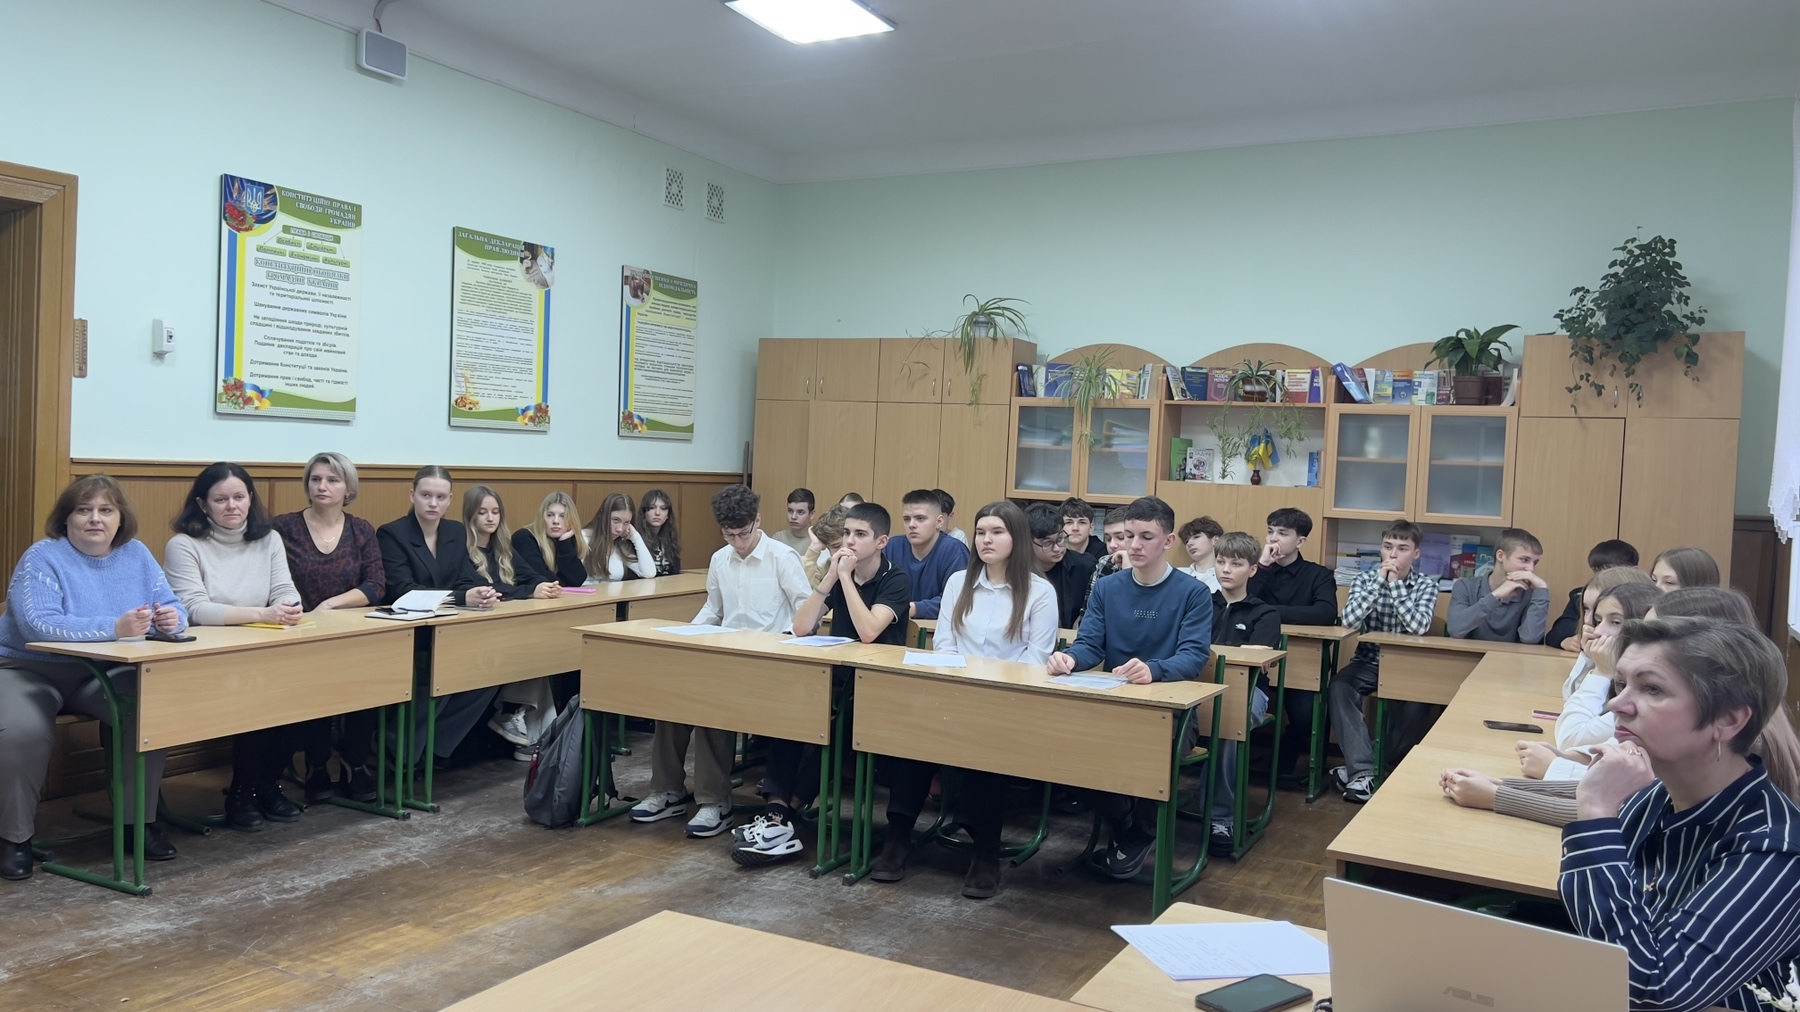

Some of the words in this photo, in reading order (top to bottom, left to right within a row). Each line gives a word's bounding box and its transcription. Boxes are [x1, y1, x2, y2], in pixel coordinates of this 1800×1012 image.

[296, 202, 323, 214] СВОБОДИ
[325, 208, 356, 221] ГРОМАДЯН
[333, 201, 354, 212] ПРАВА
[1443, 986, 1494, 1007] ASUS
